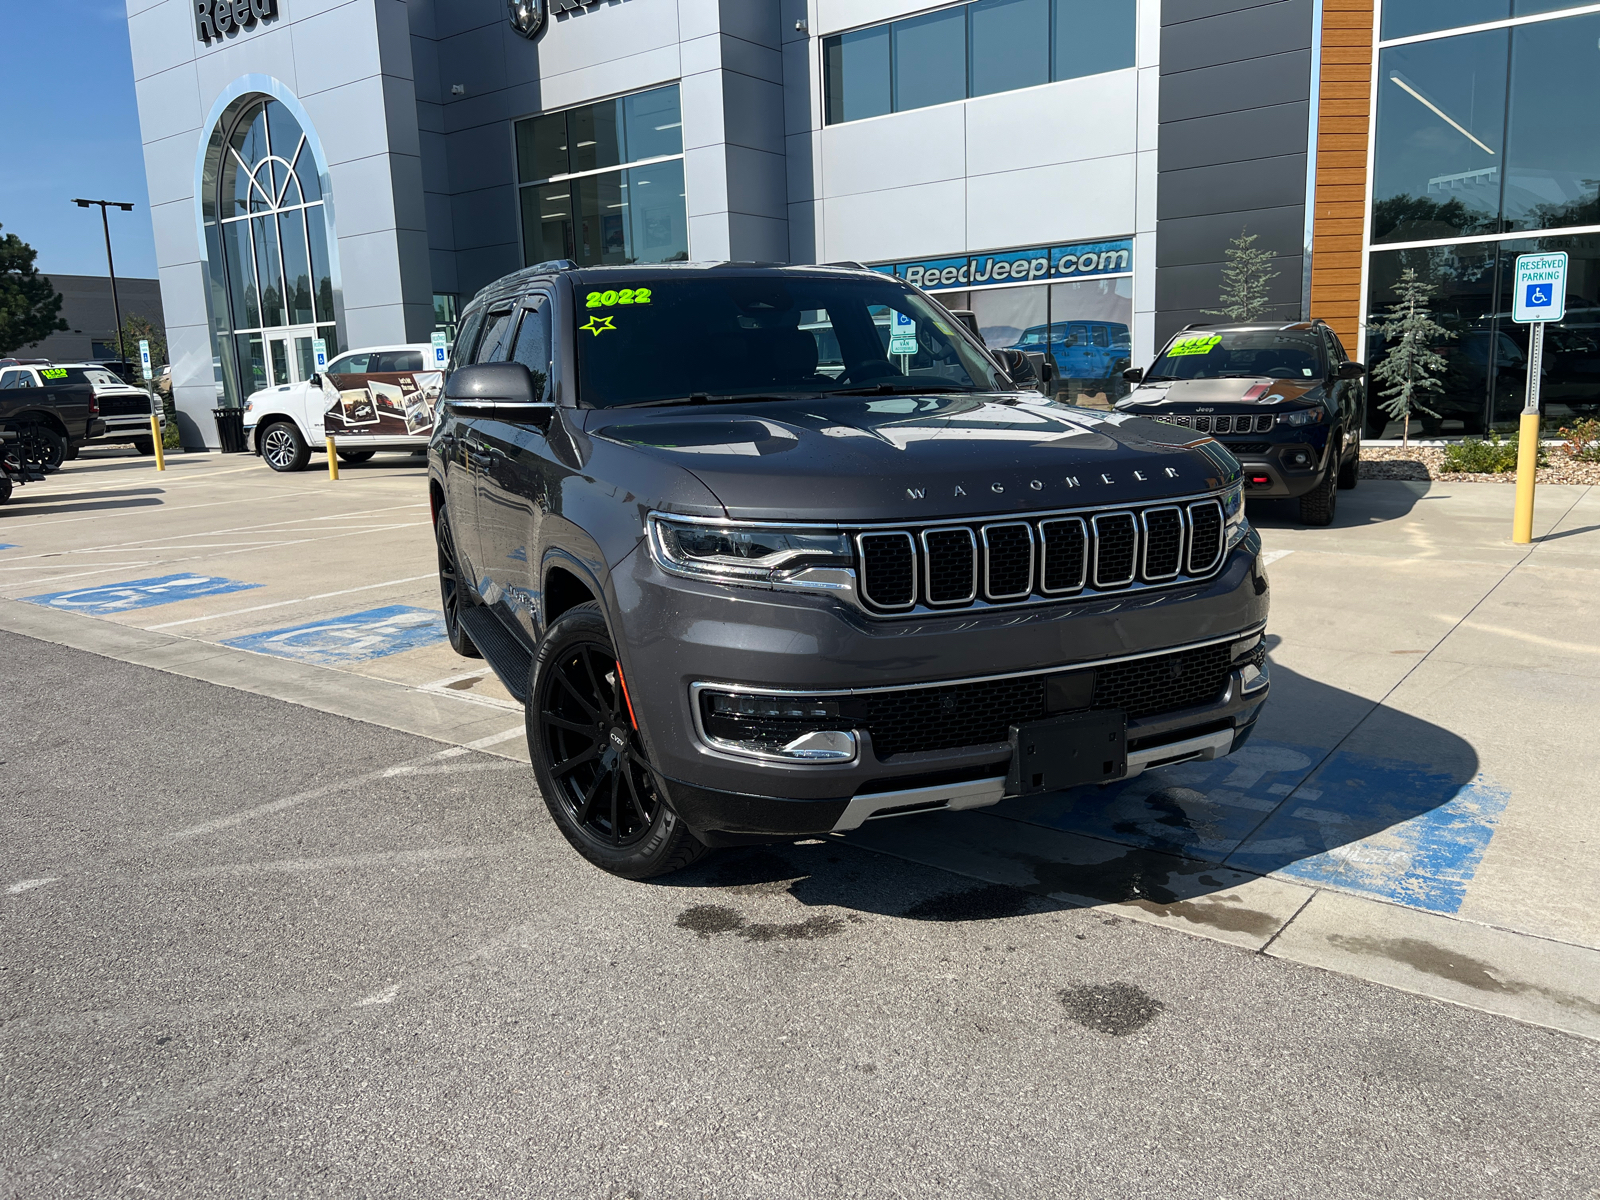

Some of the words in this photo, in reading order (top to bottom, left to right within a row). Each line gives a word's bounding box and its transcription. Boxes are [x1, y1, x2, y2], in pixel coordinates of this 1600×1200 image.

[905, 248, 1129, 287] ReedJeep.com
[1520, 259, 1563, 271] RESERVED
[1521, 271, 1560, 282] PARKING
[585, 287, 652, 308] 2022
[906, 466, 1179, 500] WAGONEER
